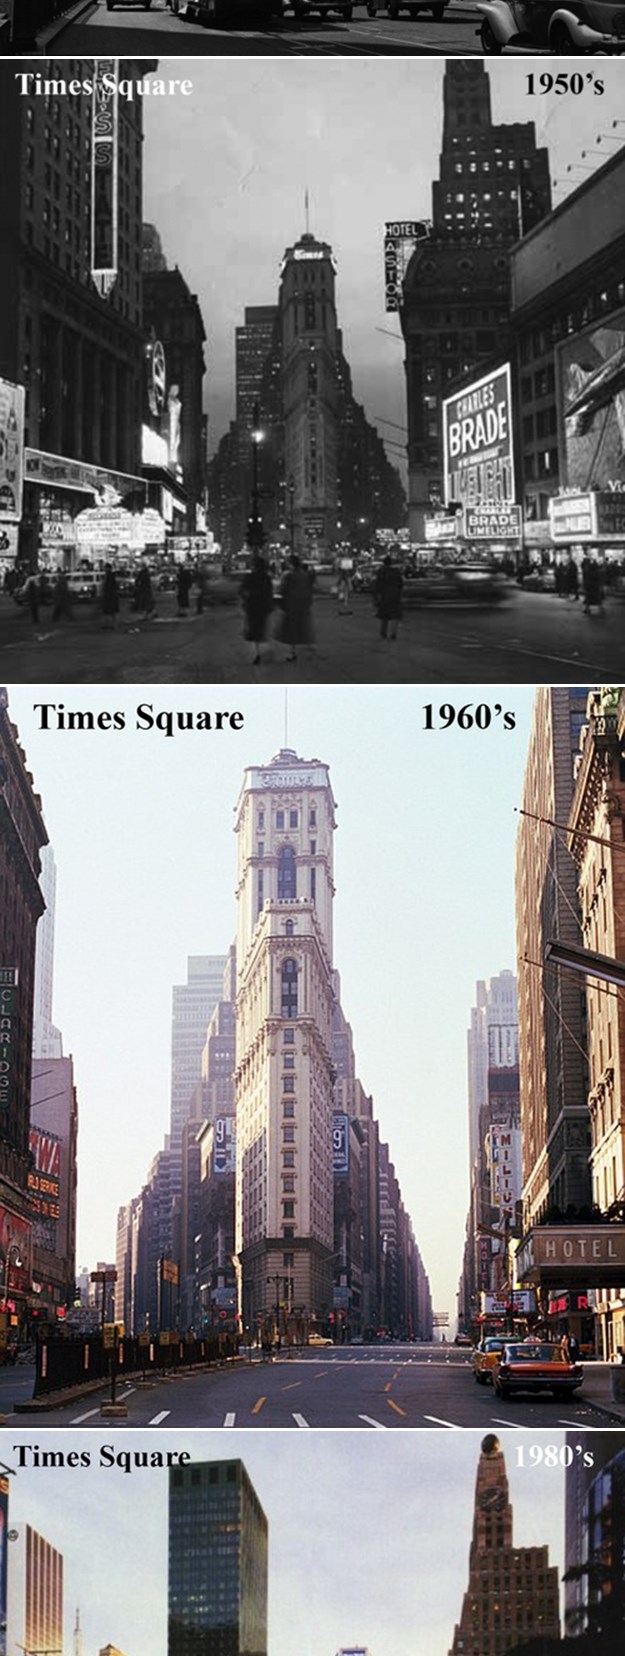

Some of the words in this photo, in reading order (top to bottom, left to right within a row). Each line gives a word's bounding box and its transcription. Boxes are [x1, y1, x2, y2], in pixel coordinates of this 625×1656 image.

[384, 223, 419, 237] HOTEL
[385, 242, 399, 308] ASTOR
[449, 400, 508, 457] BRADE
[468, 514, 518, 526] BRADE
[546, 1240, 617, 1258] HOTEL
